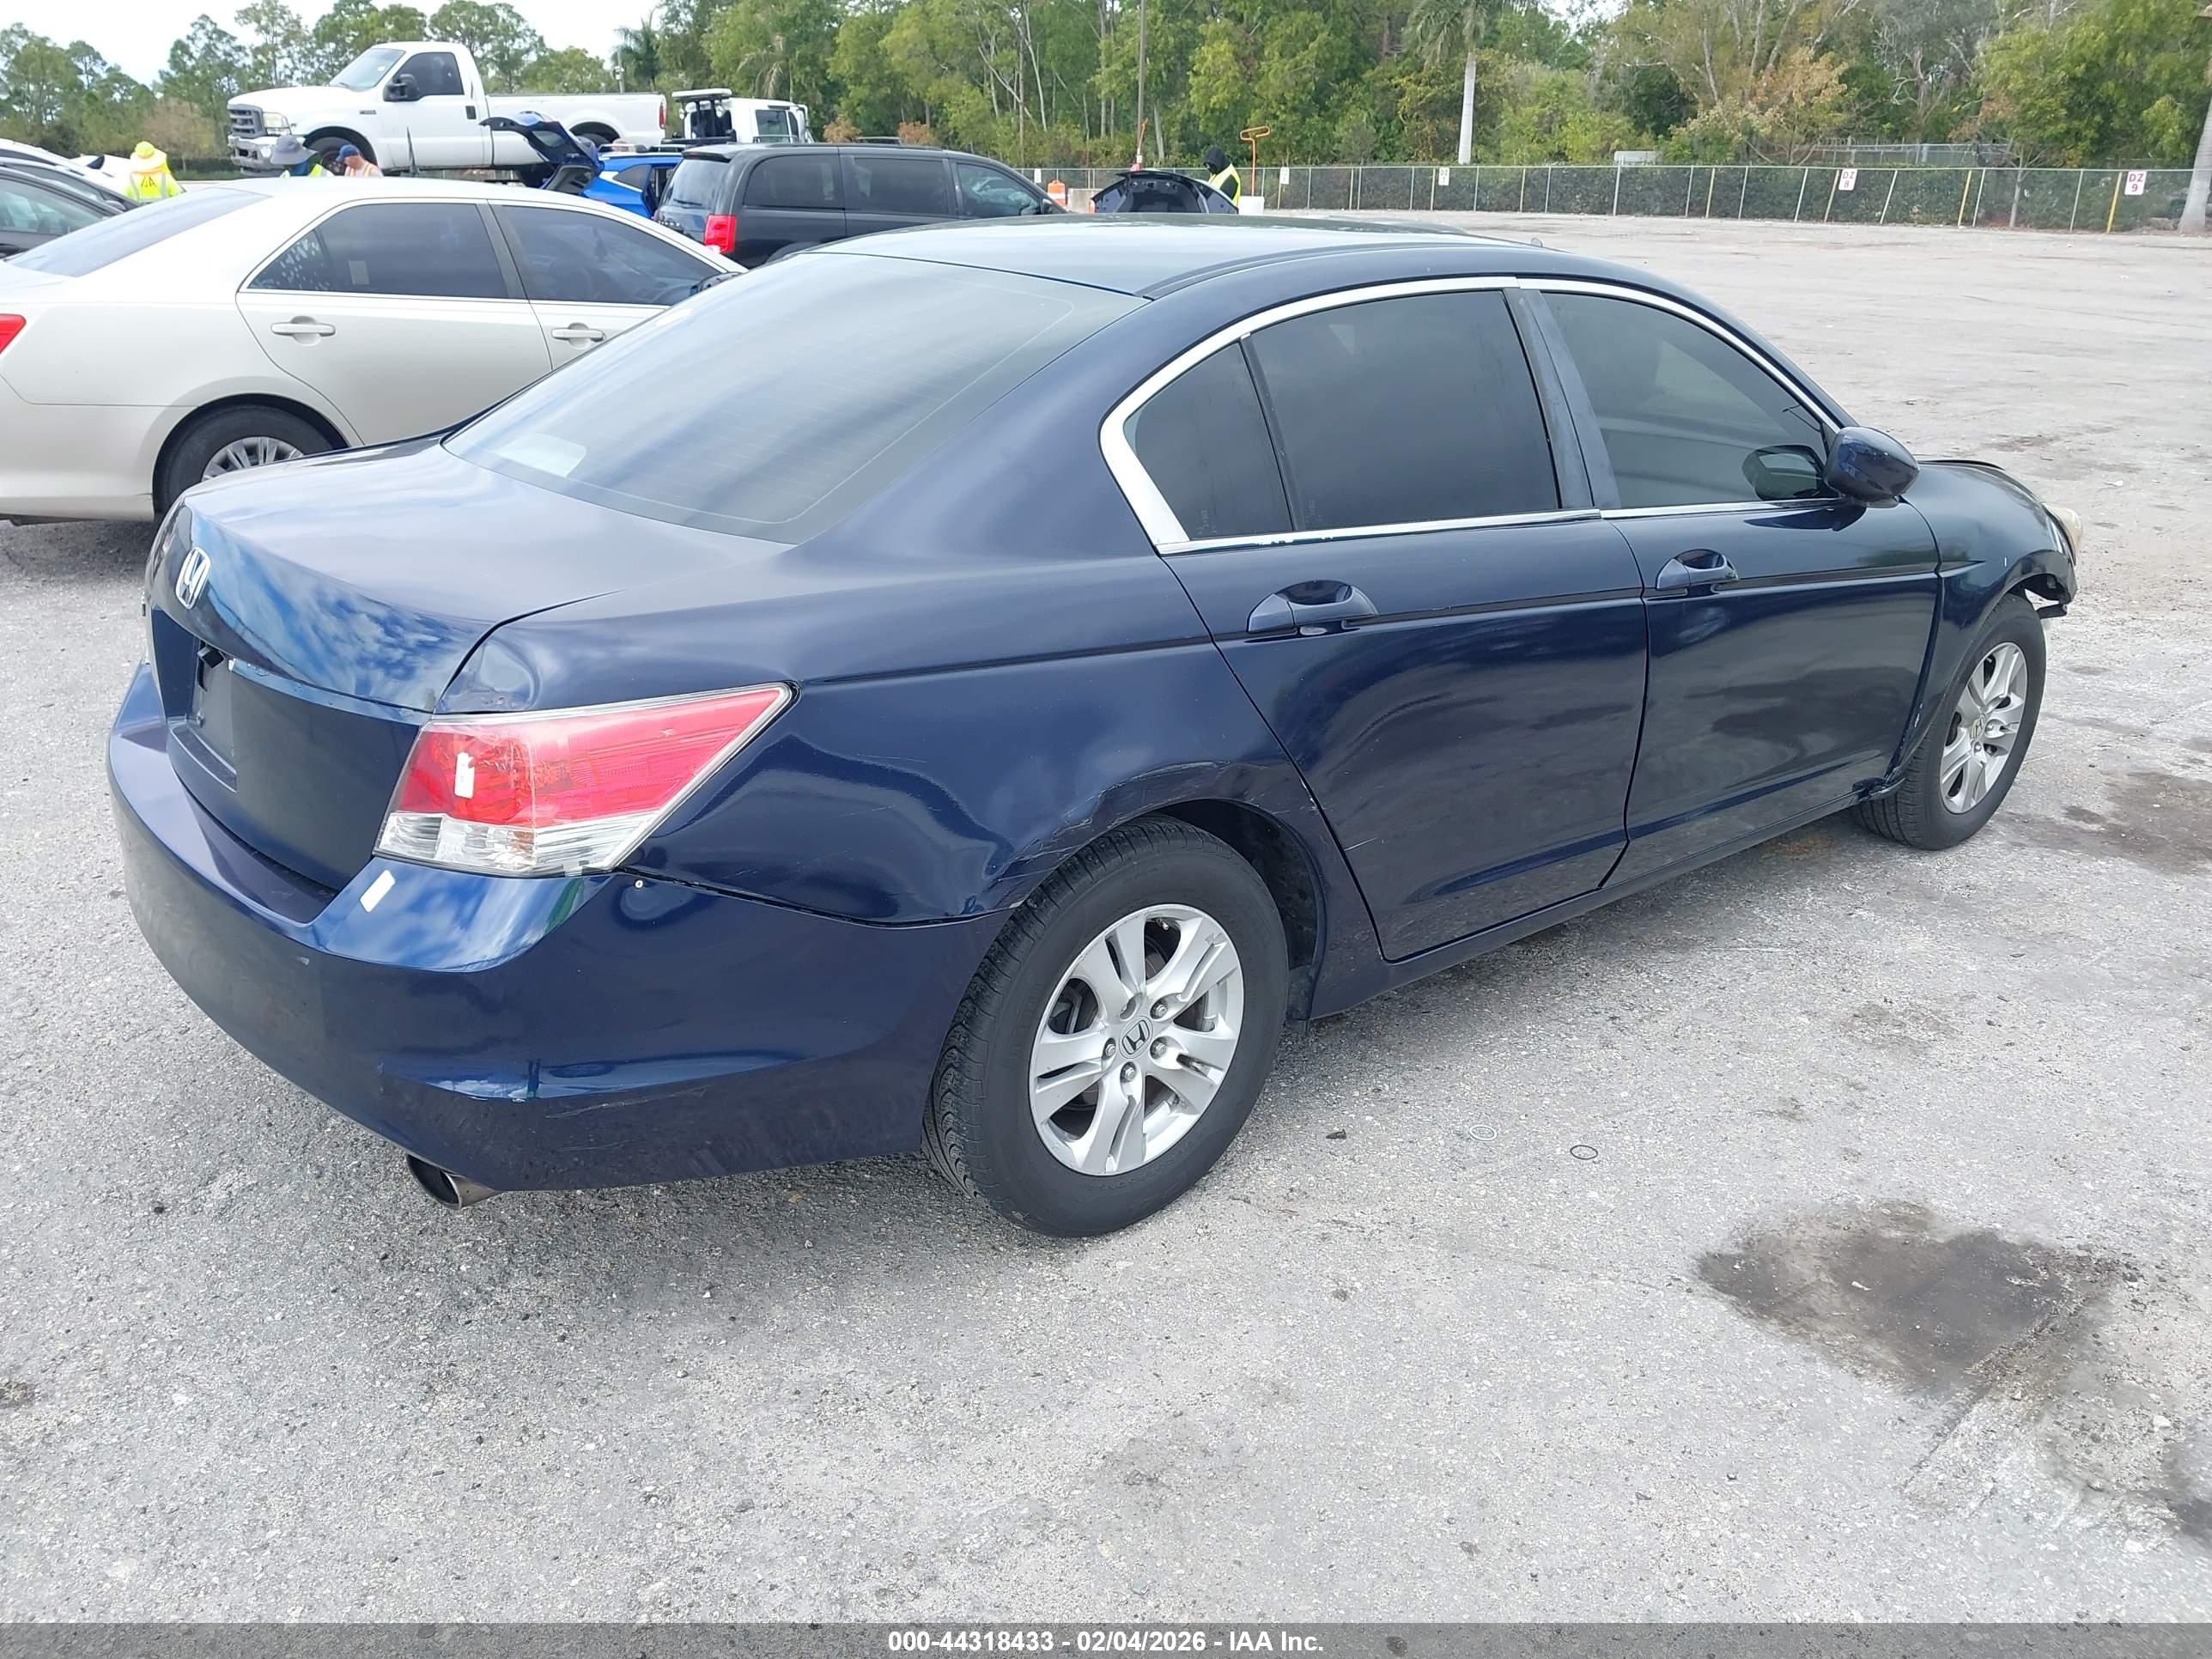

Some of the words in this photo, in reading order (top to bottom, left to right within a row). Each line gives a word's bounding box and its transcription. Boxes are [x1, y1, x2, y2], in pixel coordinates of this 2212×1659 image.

[1842, 171, 1856, 179] DZ
[2129, 173, 2144, 183] DZ
[2131, 183, 2138, 192] 9
